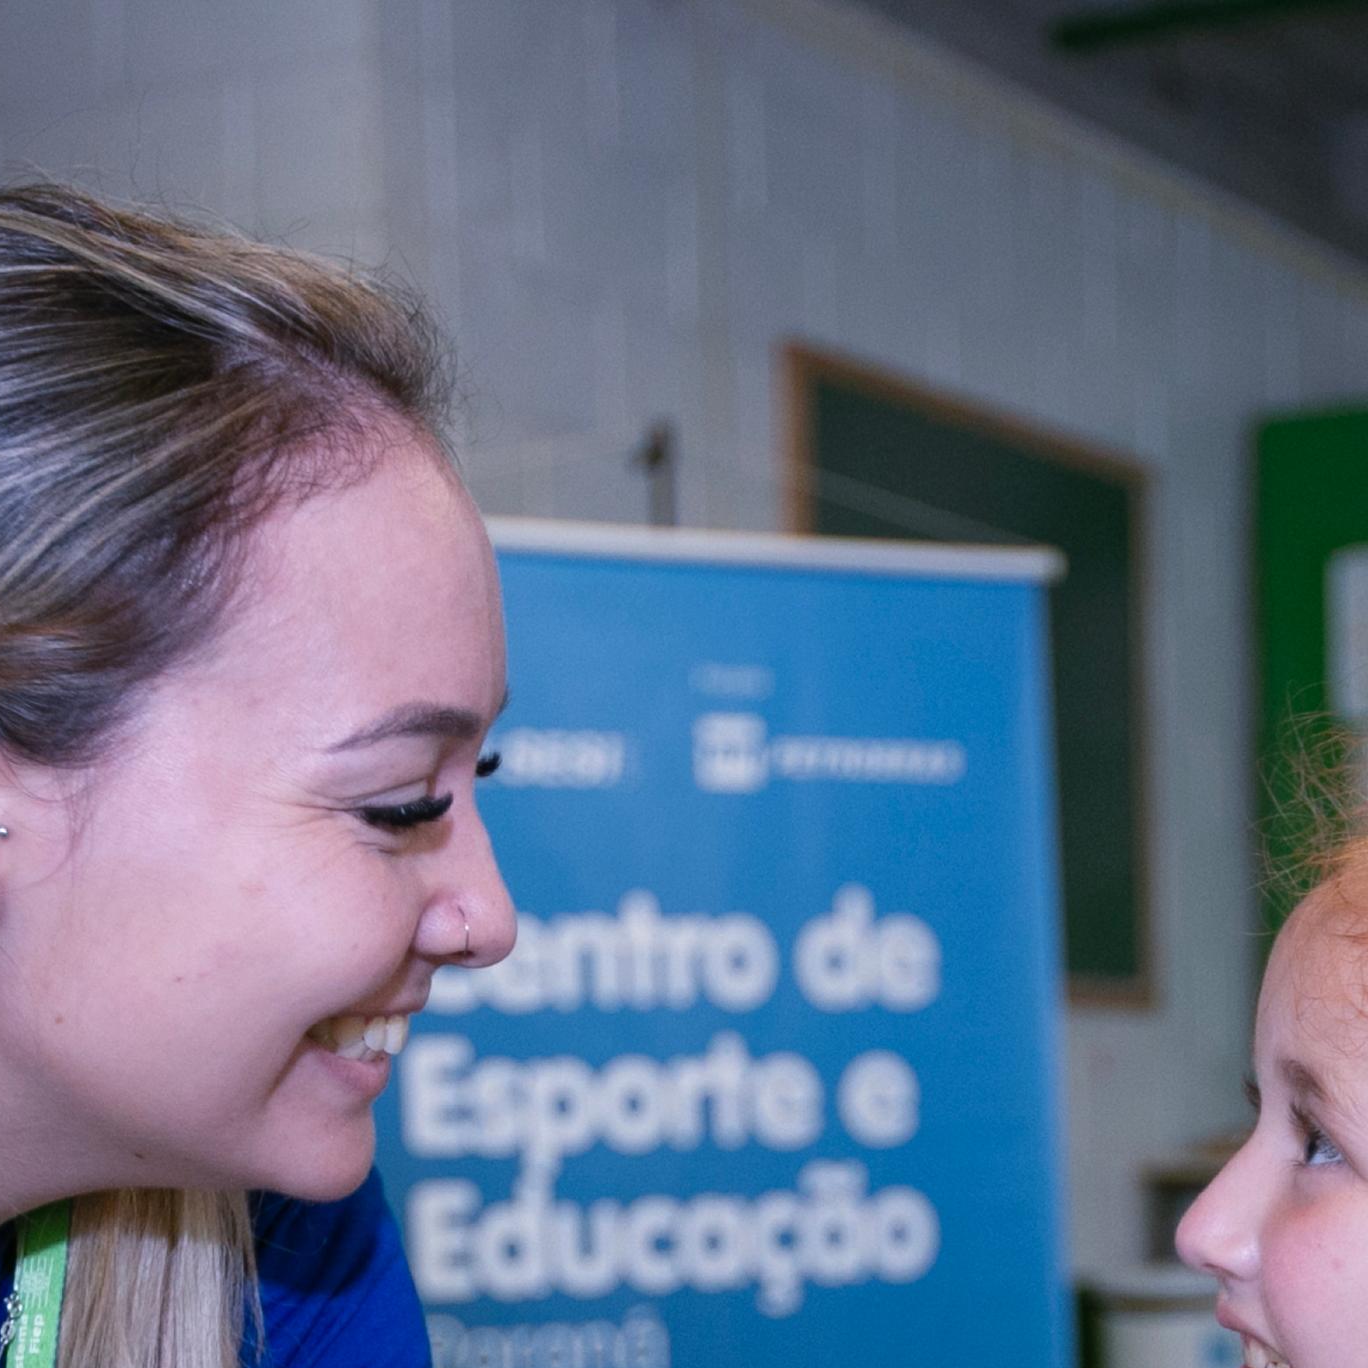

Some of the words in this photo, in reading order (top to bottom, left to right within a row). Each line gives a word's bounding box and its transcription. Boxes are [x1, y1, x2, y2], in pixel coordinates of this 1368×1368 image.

[424, 890, 779, 1012] entro
[793, 884, 940, 1012] de
[402, 1030, 824, 1170] Esporte
[838, 1048, 919, 1148] e
[408, 1160, 939, 1316] Educação
[29, 1313, 45, 1354] Fiep
